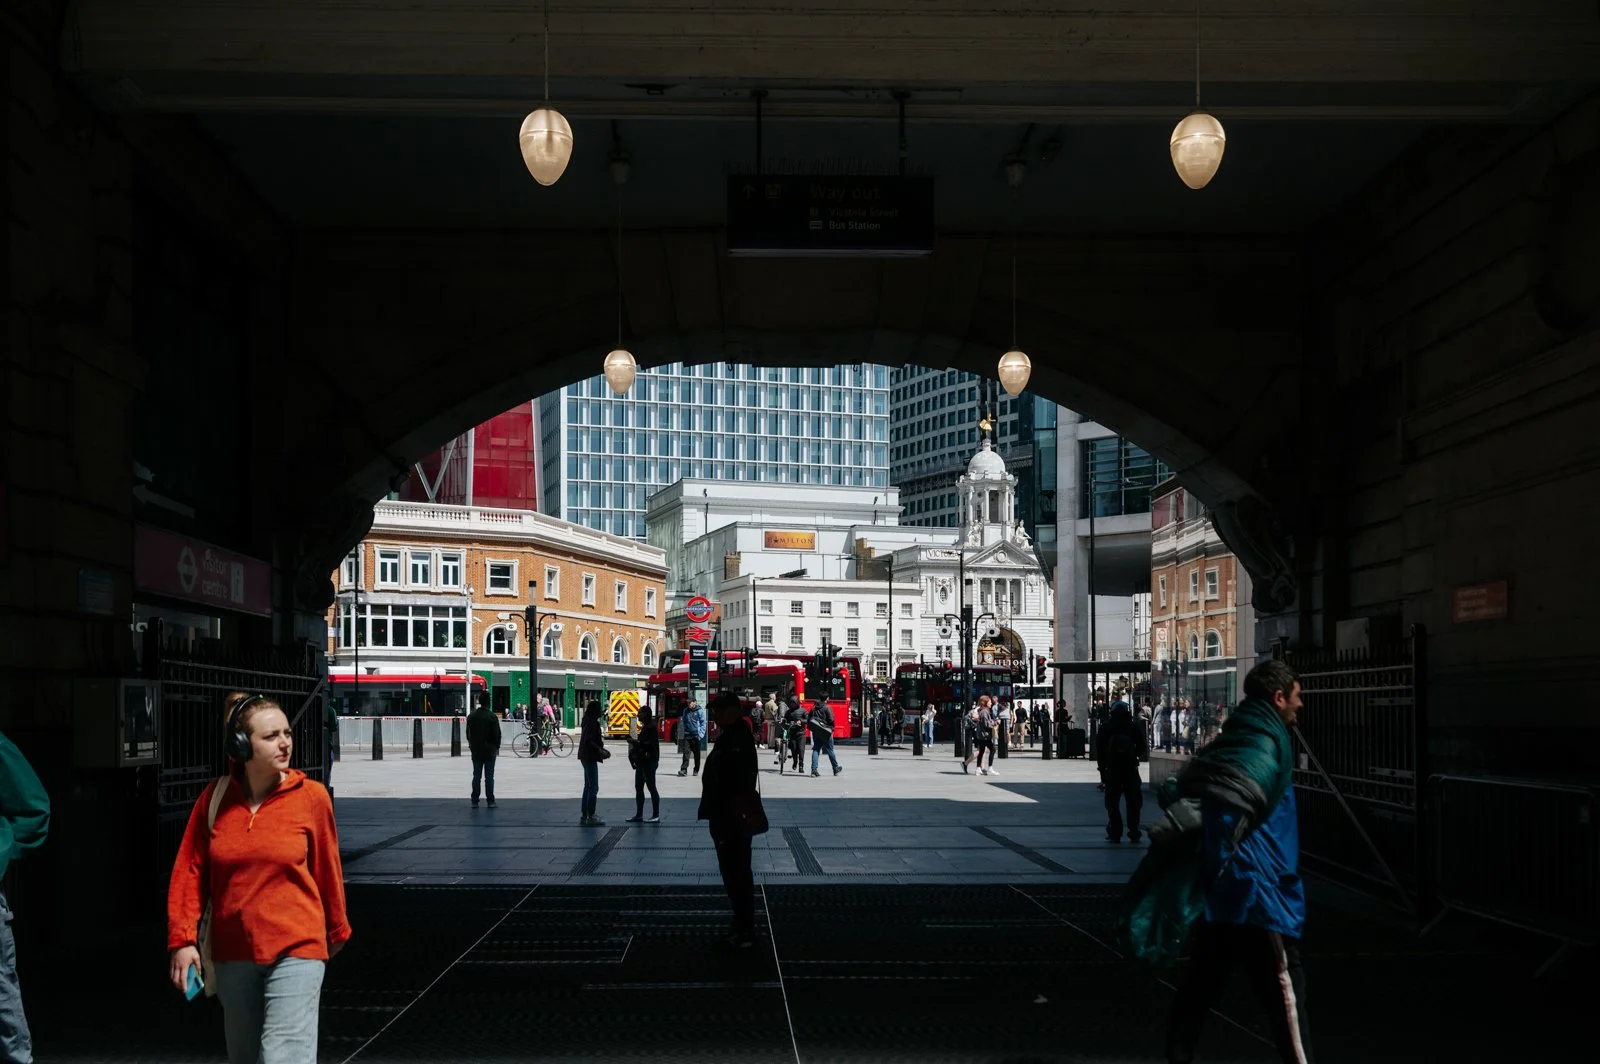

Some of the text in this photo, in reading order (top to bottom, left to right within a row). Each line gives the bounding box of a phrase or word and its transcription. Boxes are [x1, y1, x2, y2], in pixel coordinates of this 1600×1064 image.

[810, 183, 882, 203] Way out
[829, 220, 881, 230] Bus Station
